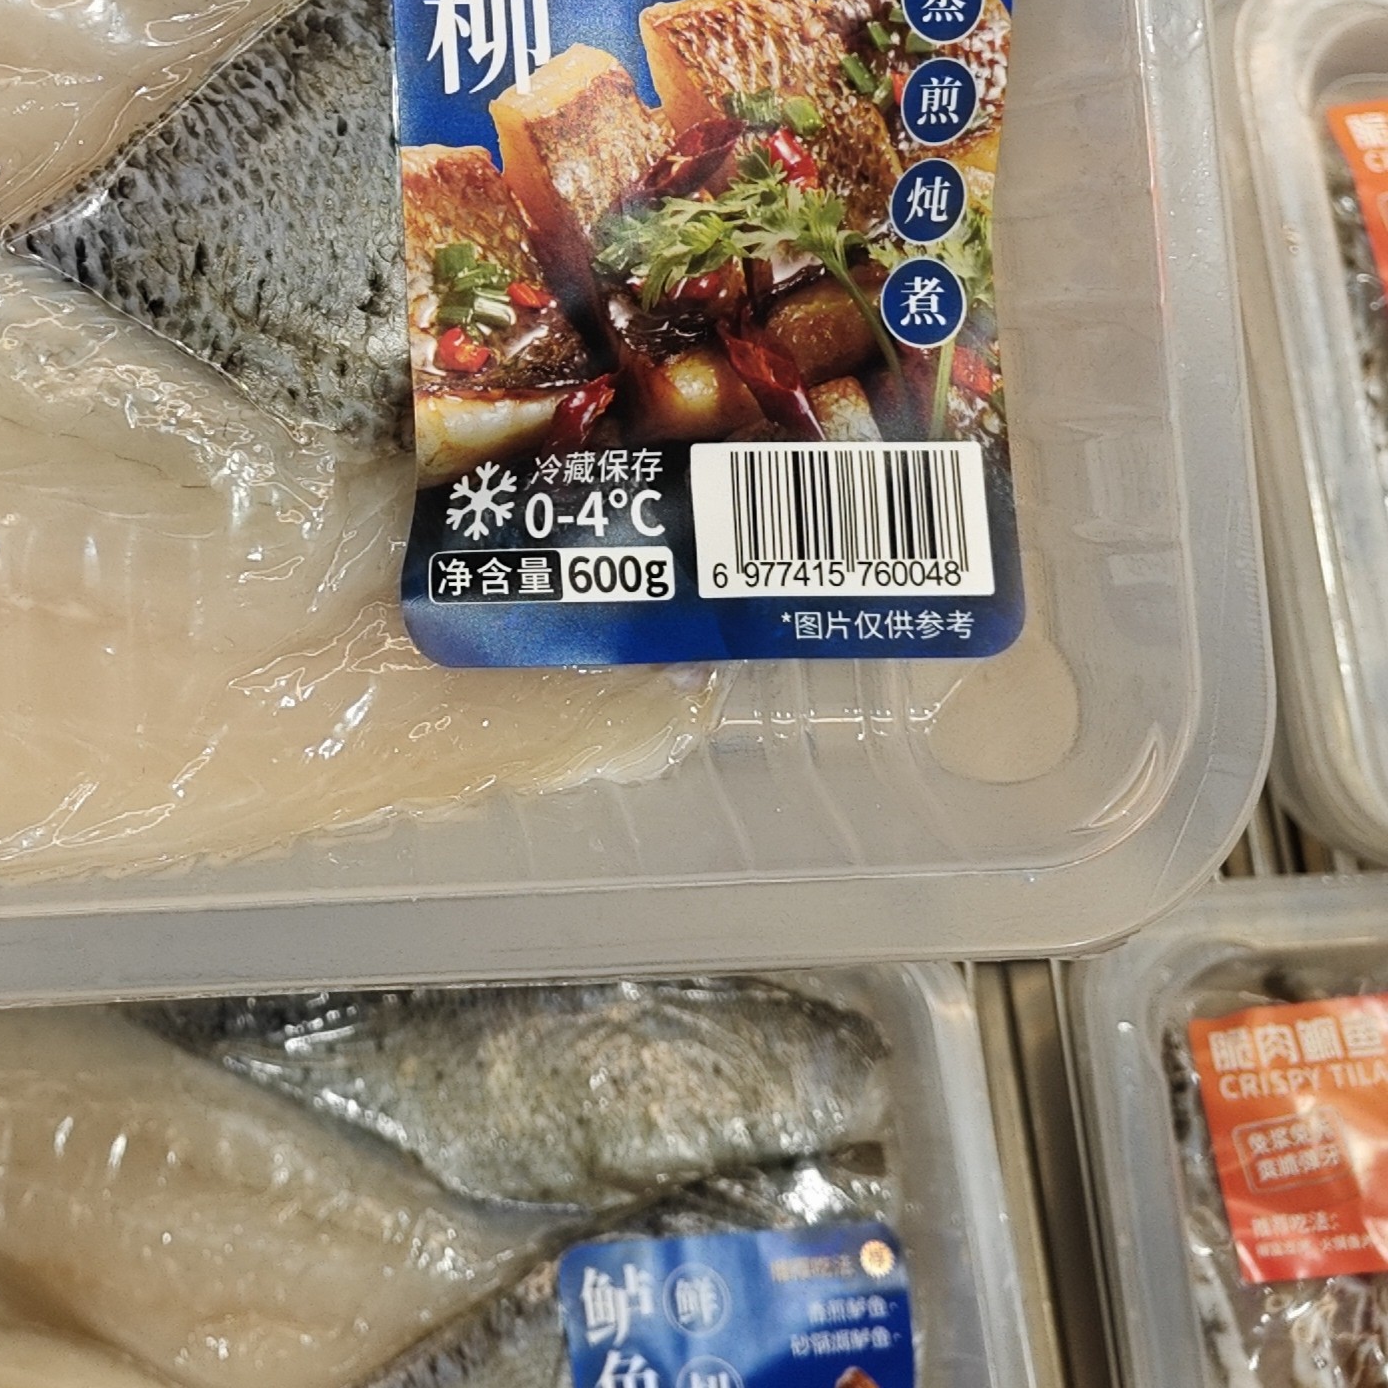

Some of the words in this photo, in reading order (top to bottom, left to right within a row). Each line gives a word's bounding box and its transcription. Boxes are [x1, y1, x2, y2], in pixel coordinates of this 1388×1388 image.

[917, 77, 962, 125] 煎
[904, 176, 951, 224] 炖
[900, 277, 946, 326] 煮
[531, 449, 663, 484] 冷藏保存
[437, 557, 554, 597] 净含量
[568, 555, 669, 597] 600g
[745, 561, 845, 587] 977415
[857, 559, 961, 587] 760048
[1219, 1065, 1319, 1100] CRISPY
